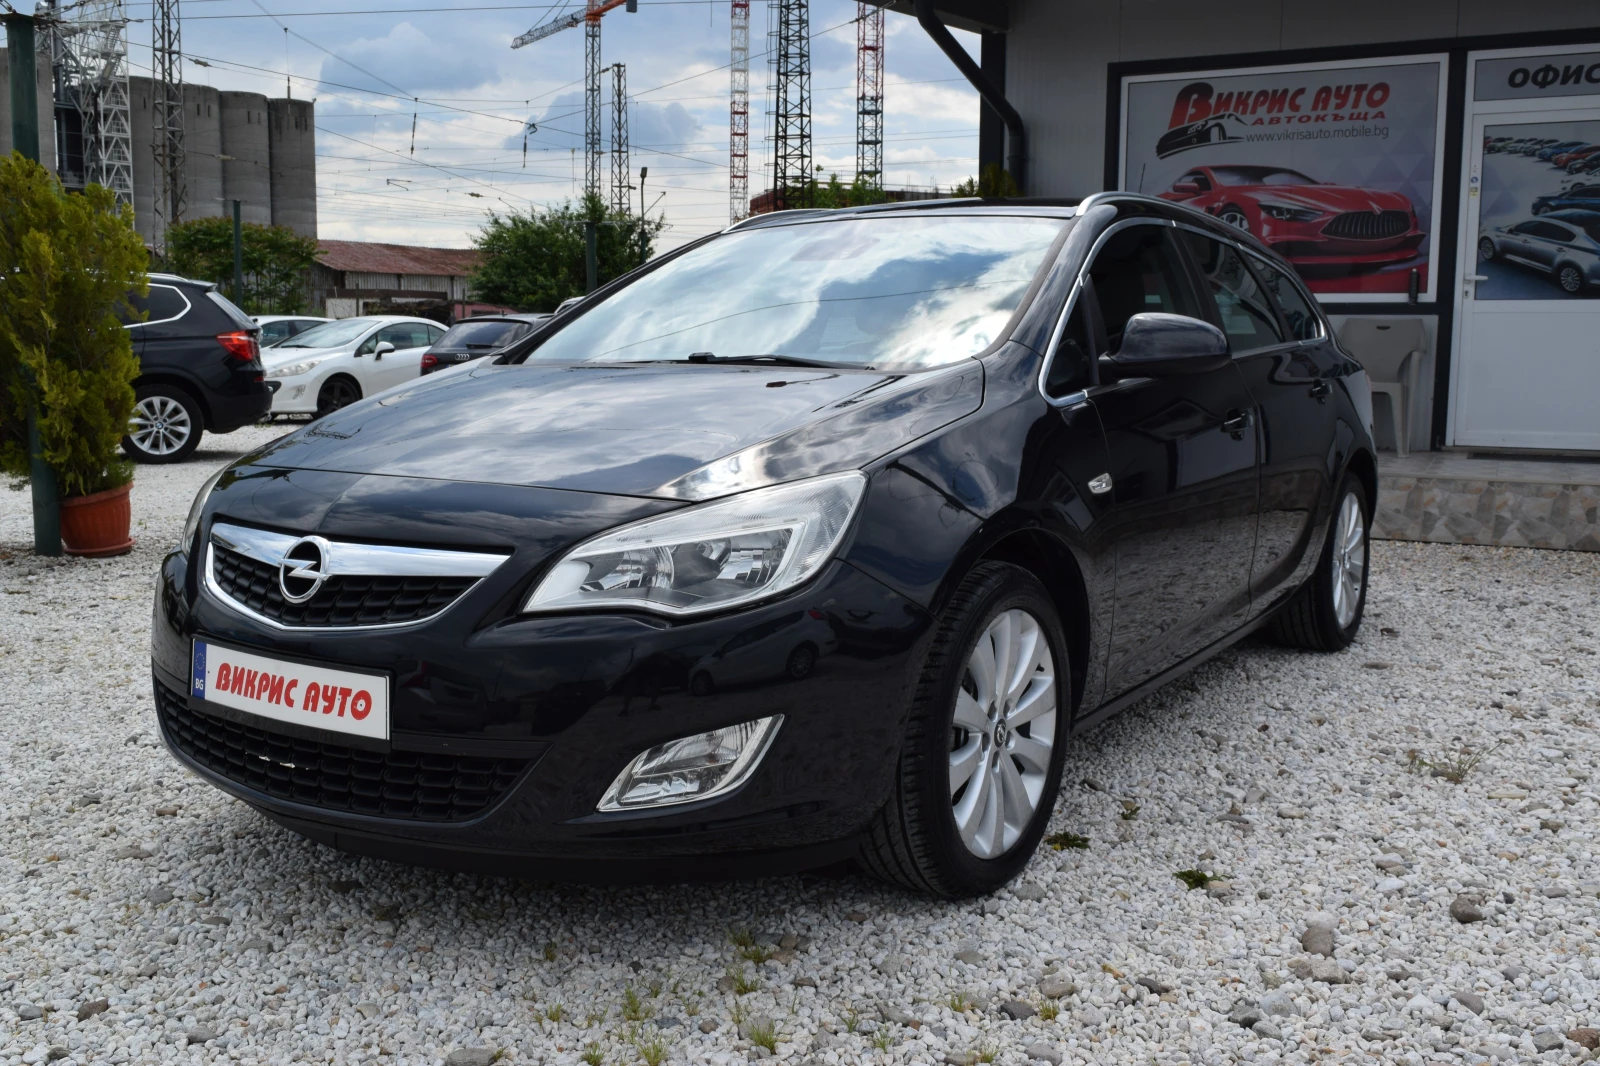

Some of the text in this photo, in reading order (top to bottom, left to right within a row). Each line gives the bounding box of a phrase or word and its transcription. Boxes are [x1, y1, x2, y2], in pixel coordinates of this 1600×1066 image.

[1311, 82, 1390, 111] АУТО
[1251, 110, 1386, 126] АВТОКЪЩА
[1246, 125, 1389, 143] www.vikrisauto.mobile.bg
[195, 678, 204, 690] BG
[215, 663, 372, 720] ВИКРИС АУТО
